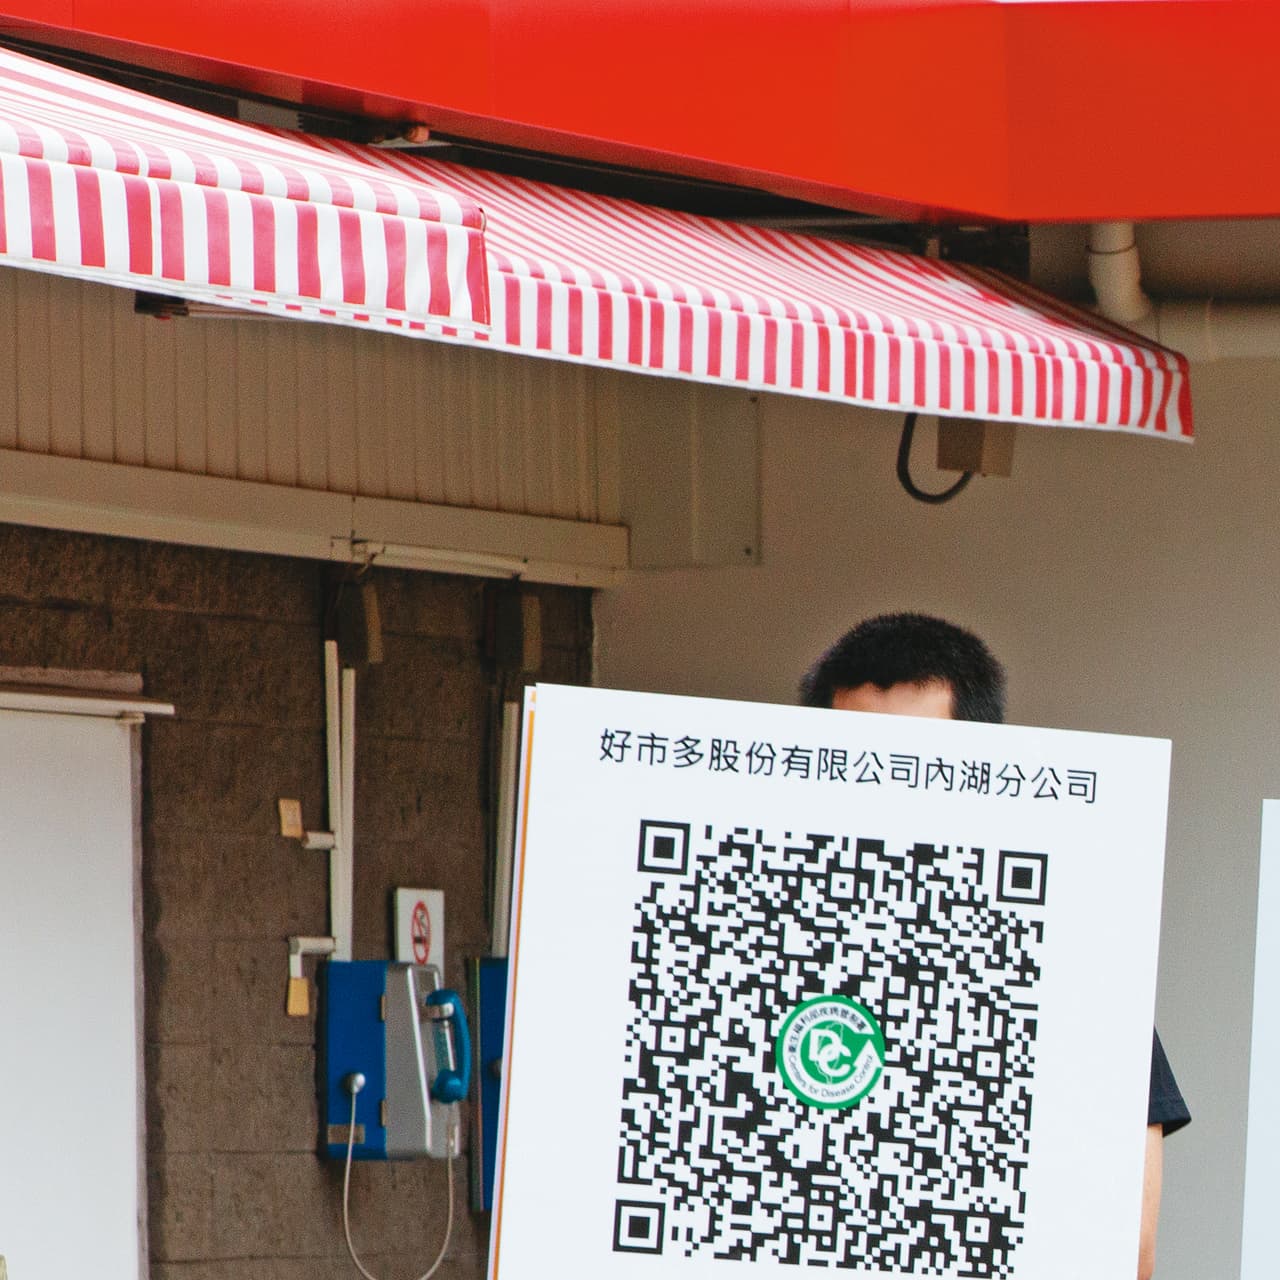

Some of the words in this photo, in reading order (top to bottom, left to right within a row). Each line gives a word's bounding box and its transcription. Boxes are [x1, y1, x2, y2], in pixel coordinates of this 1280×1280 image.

[599, 727, 1098, 805] 好市多股份有限公司內湖分公司
